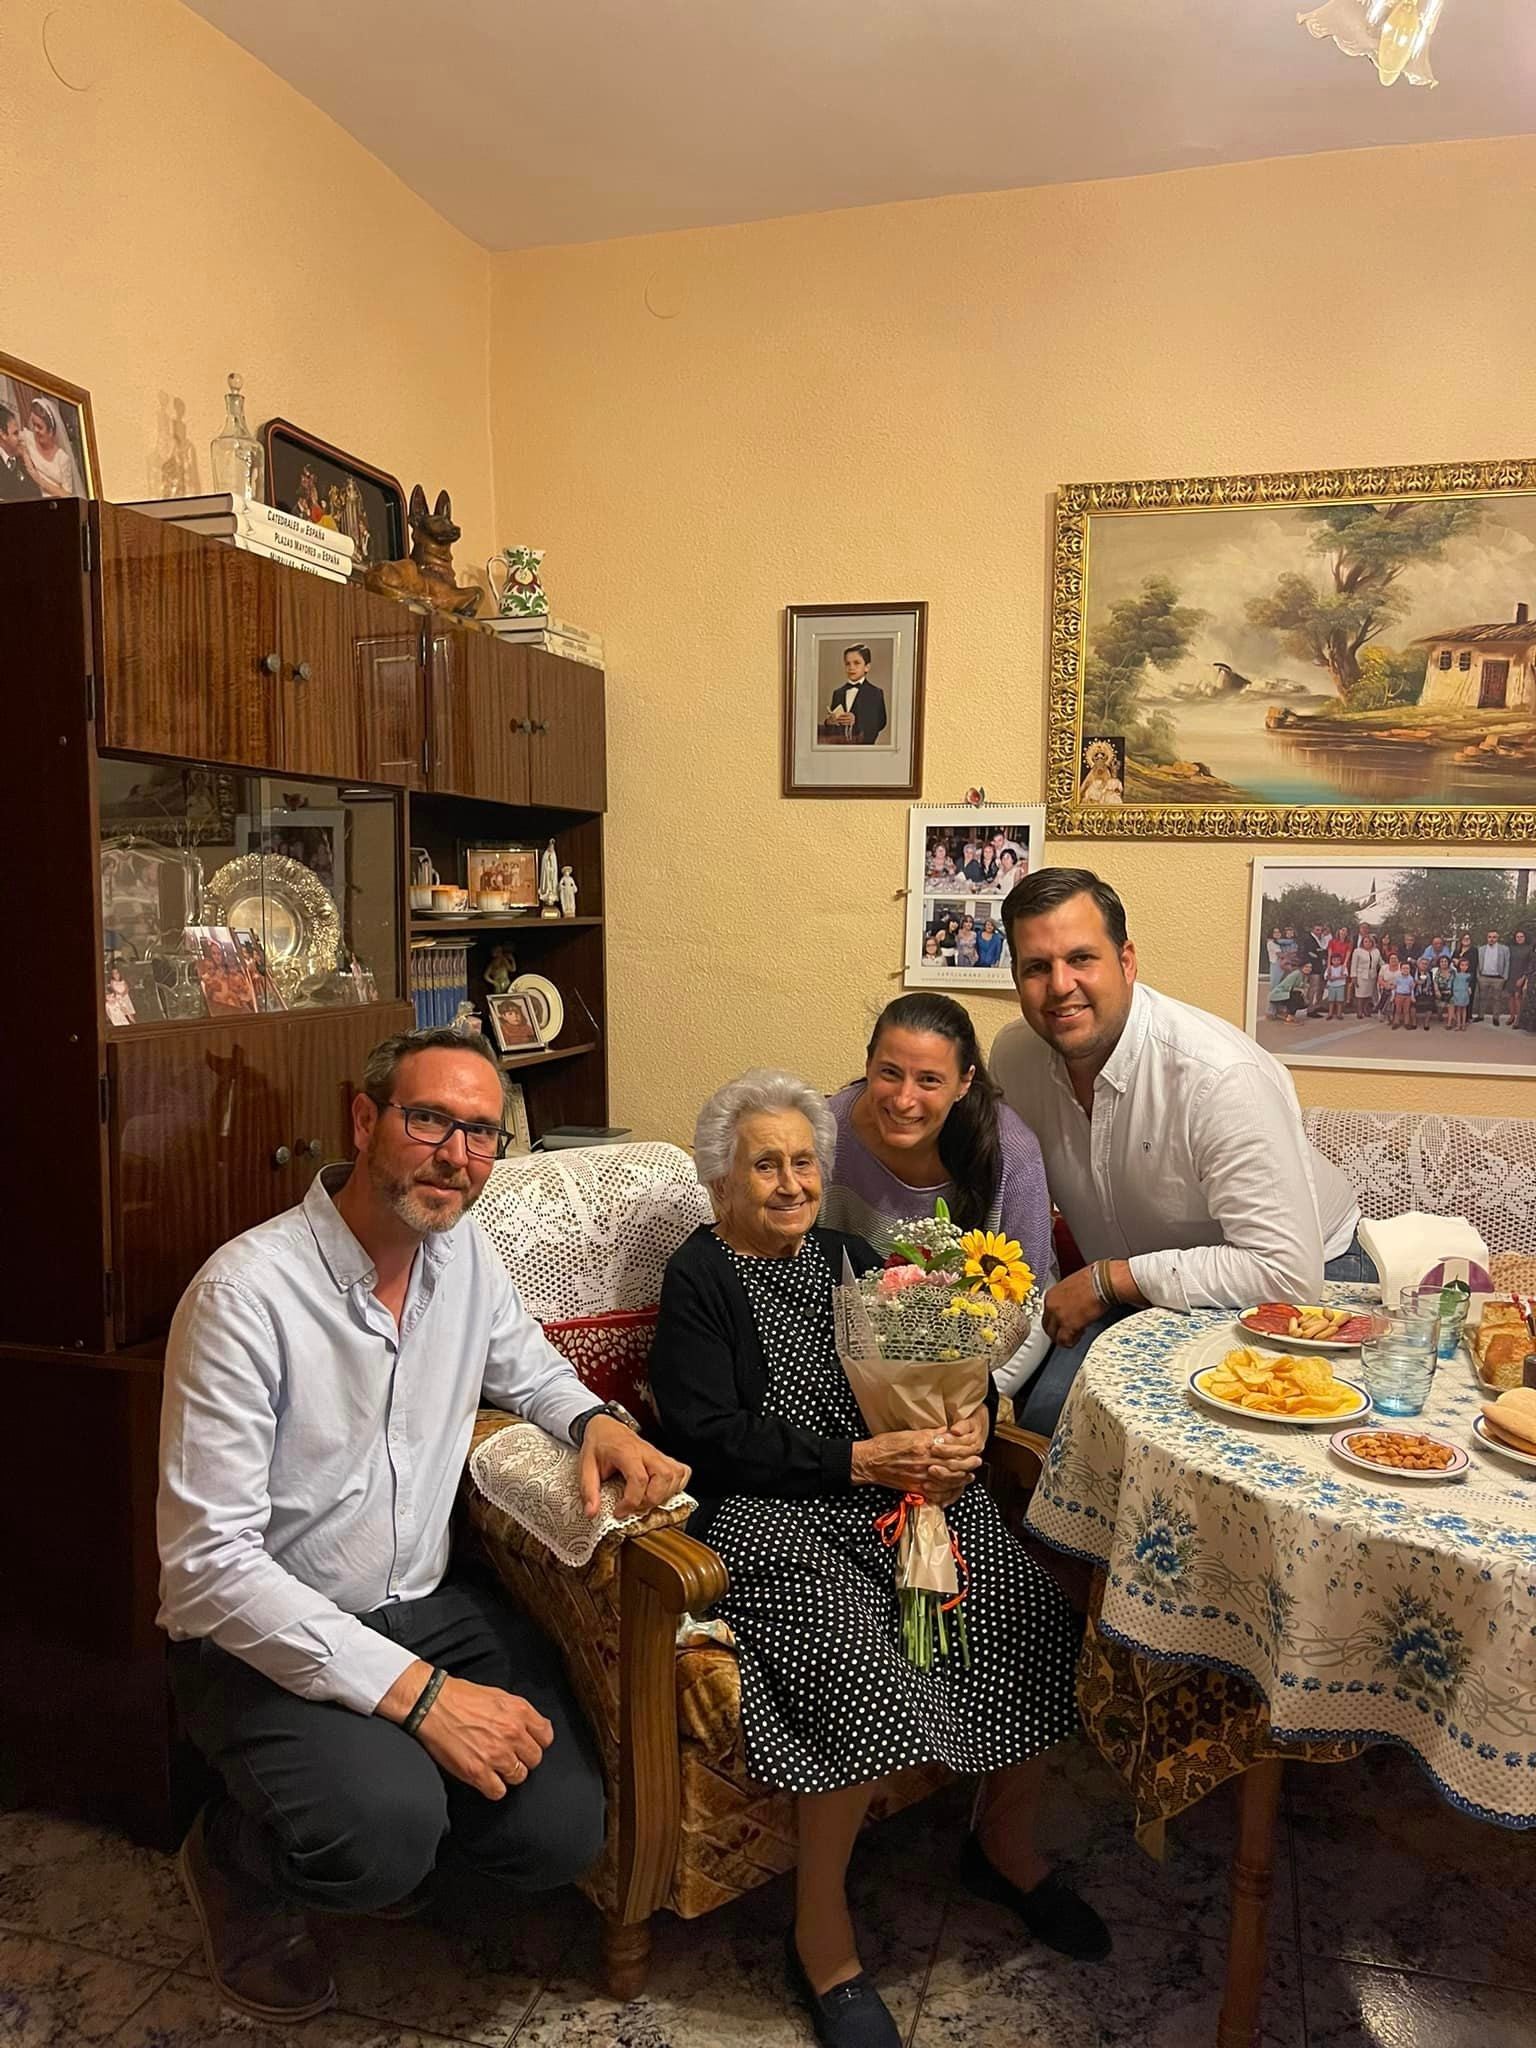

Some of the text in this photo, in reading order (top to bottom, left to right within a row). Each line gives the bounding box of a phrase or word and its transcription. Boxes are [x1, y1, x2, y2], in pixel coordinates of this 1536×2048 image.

[267, 510, 299, 531] CATEDRALES
[305, 525, 325, 541] ESPAÑA
[274, 532, 293, 548] PLAZAS
[294, 540, 317, 558] MAYORES
[322, 550, 340, 565] ESPAÑA
